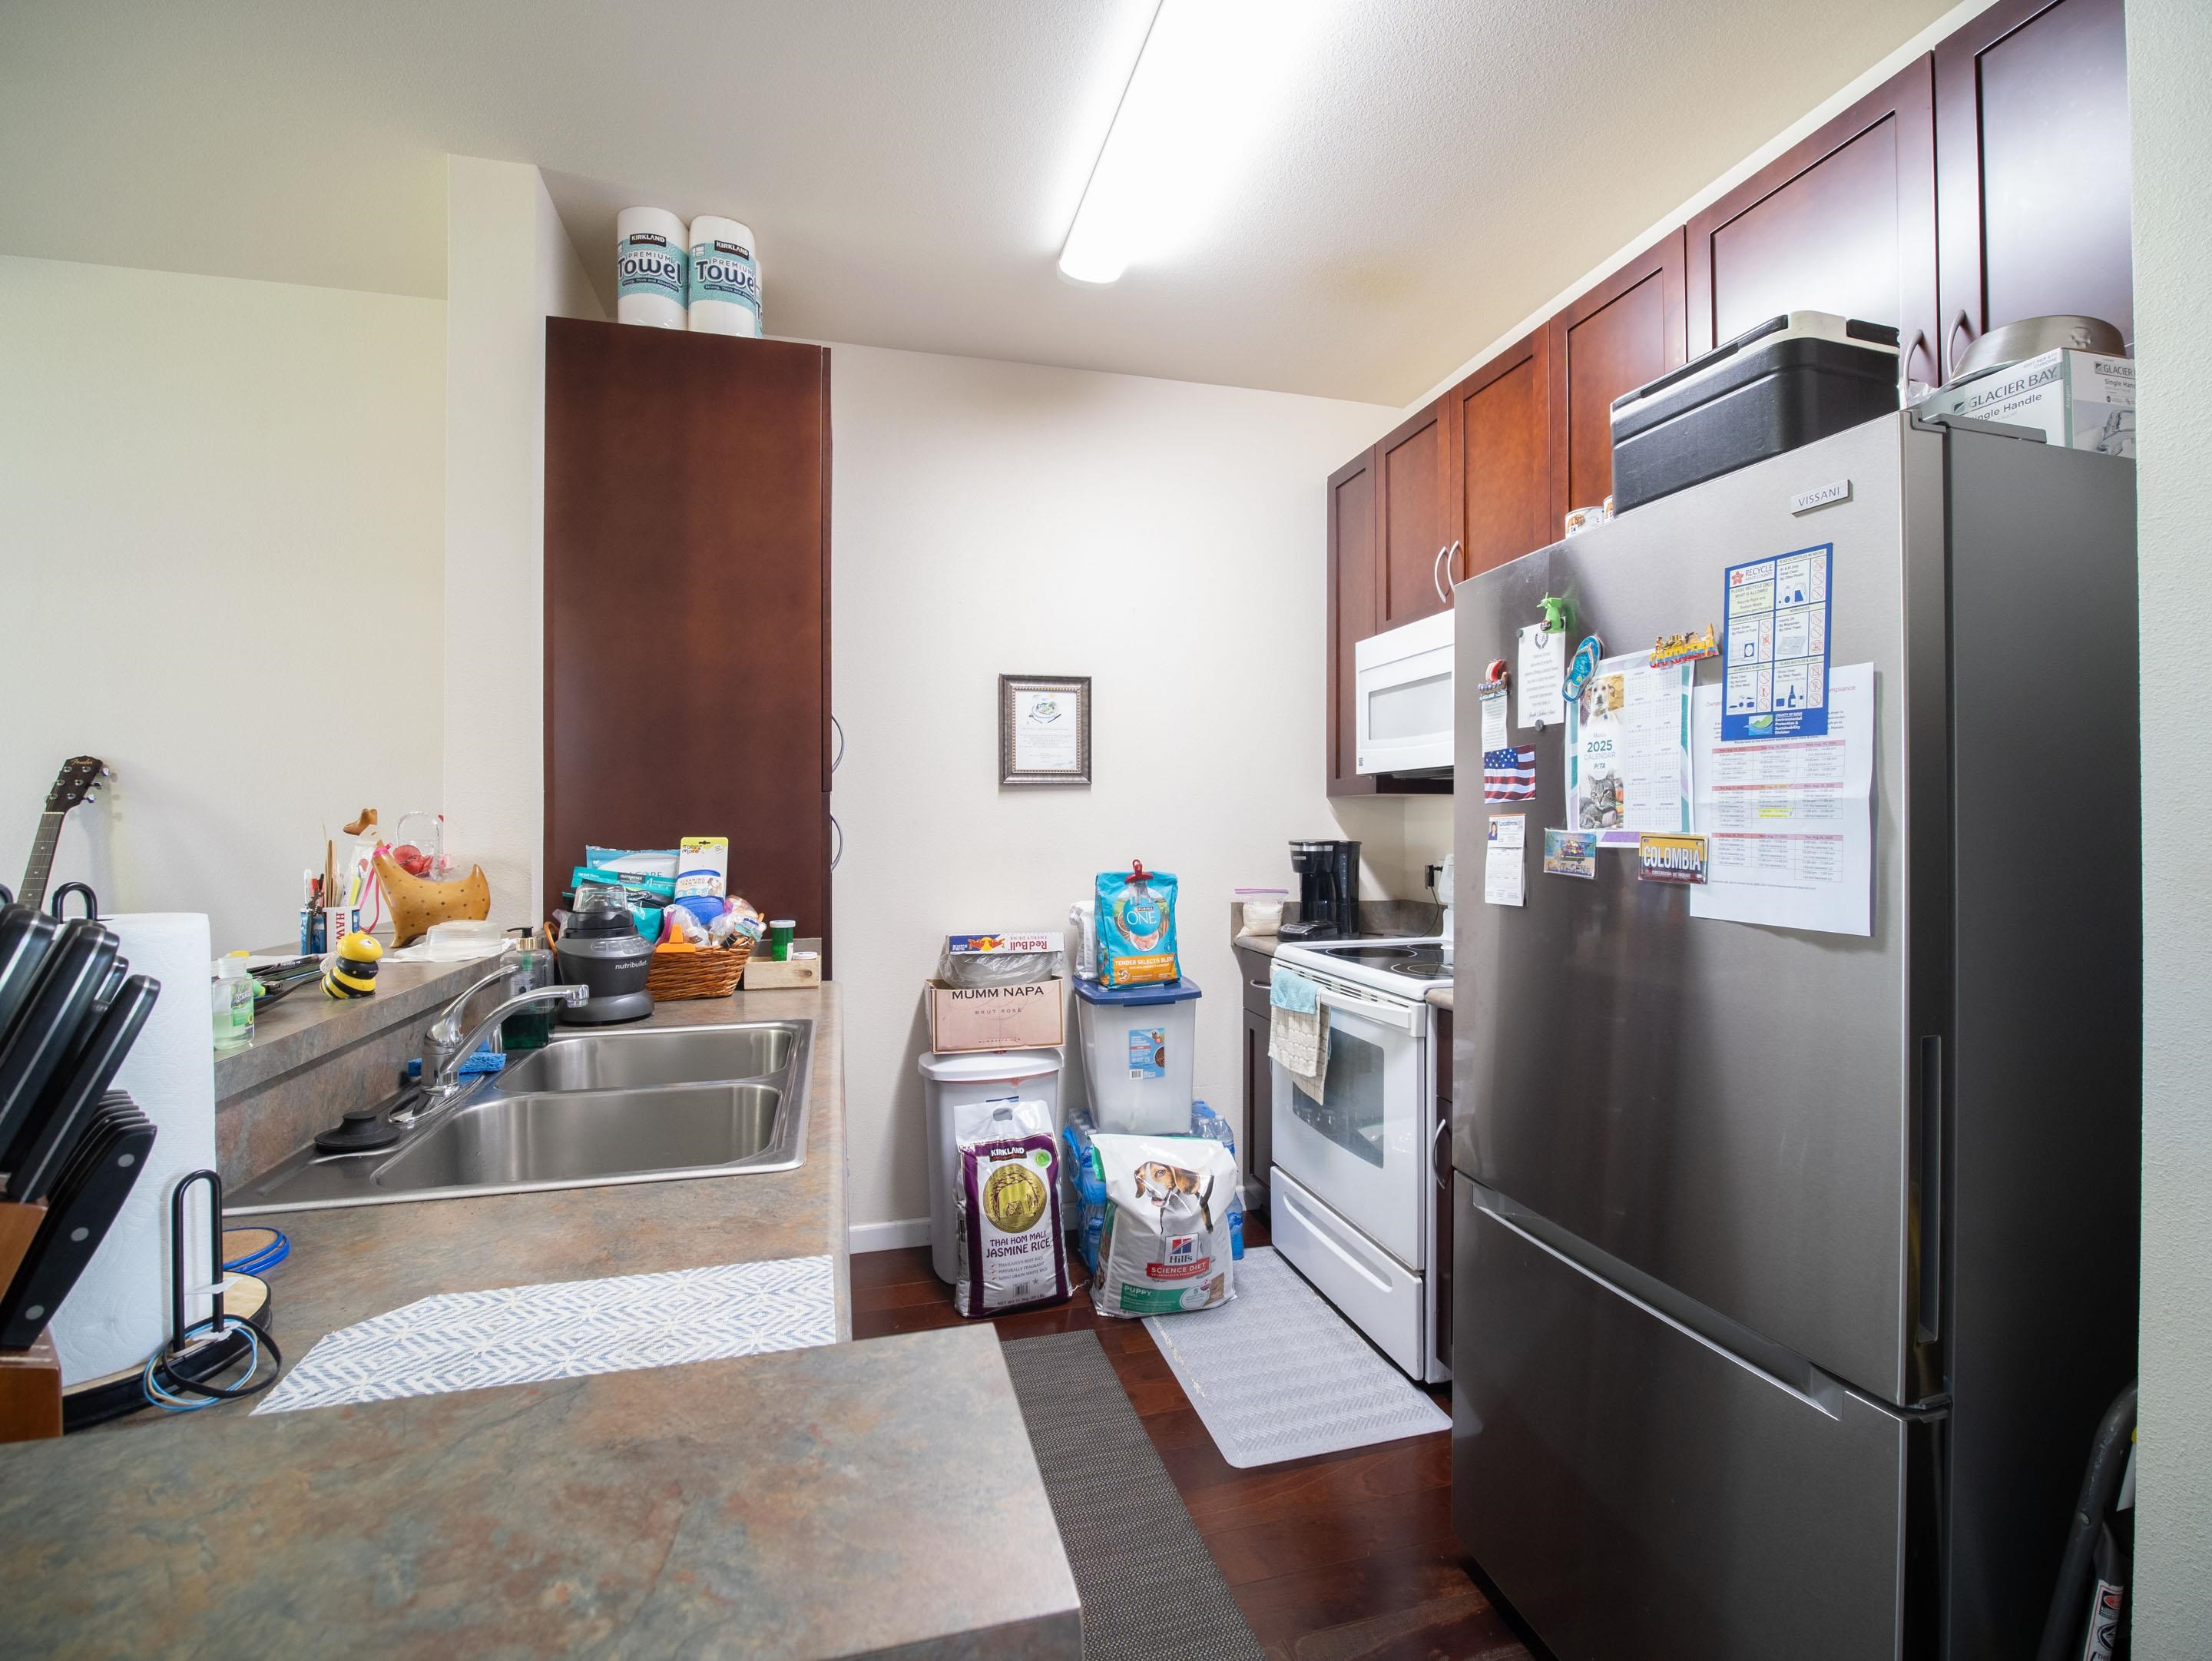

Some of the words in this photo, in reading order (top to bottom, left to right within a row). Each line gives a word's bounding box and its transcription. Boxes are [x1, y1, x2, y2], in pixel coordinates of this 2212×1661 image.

[631, 234, 665, 243] KIRKLAND
[716, 241, 748, 256] KIRKLAND
[628, 251, 671, 262] PREMIUM
[618, 257, 682, 285] Towel
[712, 258, 752, 274] PREMIUM
[696, 260, 754, 293] Towe
[2103, 364, 2133, 376] GLACIER
[1969, 379, 2025, 409] GLACIER
[2028, 365, 2058, 390] BAY
[1971, 407, 2000, 421] ingle
[2003, 393, 2042, 416] Handle
[1798, 486, 1839, 507] VISSANI
[1745, 563, 1773, 577] RECYCLE
[1587, 739, 1613, 753] 2025
[1584, 751, 1616, 761] CALENDAR
[1644, 846, 1701, 871] COLOMBIA
[1126, 910, 1157, 925] ONE
[615, 960, 647, 970] nutribullet
[952, 988, 998, 1000] MUMM
[1003, 986, 1045, 997] NAPA
[991, 1146, 1025, 1157] KIRKLAND
[990, 1238, 1008, 1247] THAI
[1010, 1235, 1028, 1245] HOM
[1029, 1231, 1046, 1241] MALI
[986, 1244, 1029, 1258] JASMINE
[1031, 1238, 1051, 1252] RICE
[1023, 1261, 1045, 1270] FRAGRANT
[1169, 1255, 1193, 1263] Hill's
[1189, 1262, 1205, 1271] DIET
[1124, 1285, 1152, 1296] PUPPY
